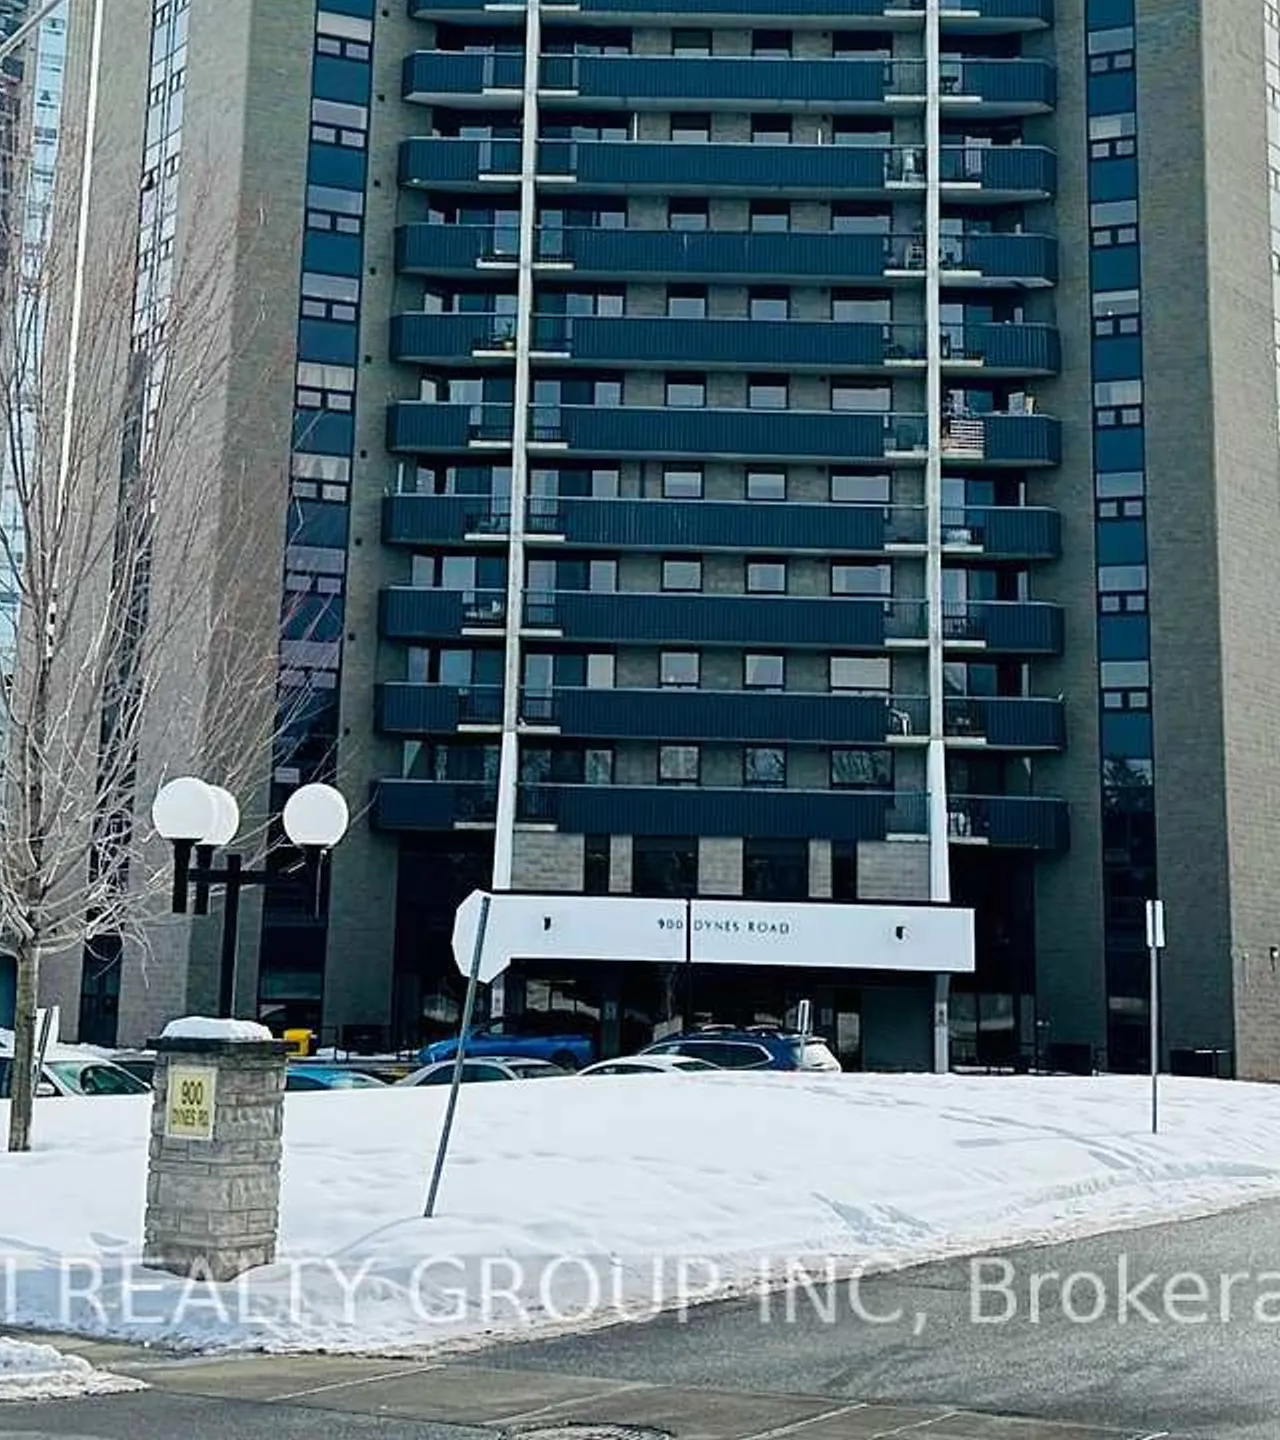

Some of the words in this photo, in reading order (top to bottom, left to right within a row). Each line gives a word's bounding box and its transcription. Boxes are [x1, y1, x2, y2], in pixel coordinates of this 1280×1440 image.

[657, 919, 683, 930] 900
[694, 920, 740, 933] DYNES
[747, 921, 790, 934] ROAD
[182, 1080, 204, 1105] 900
